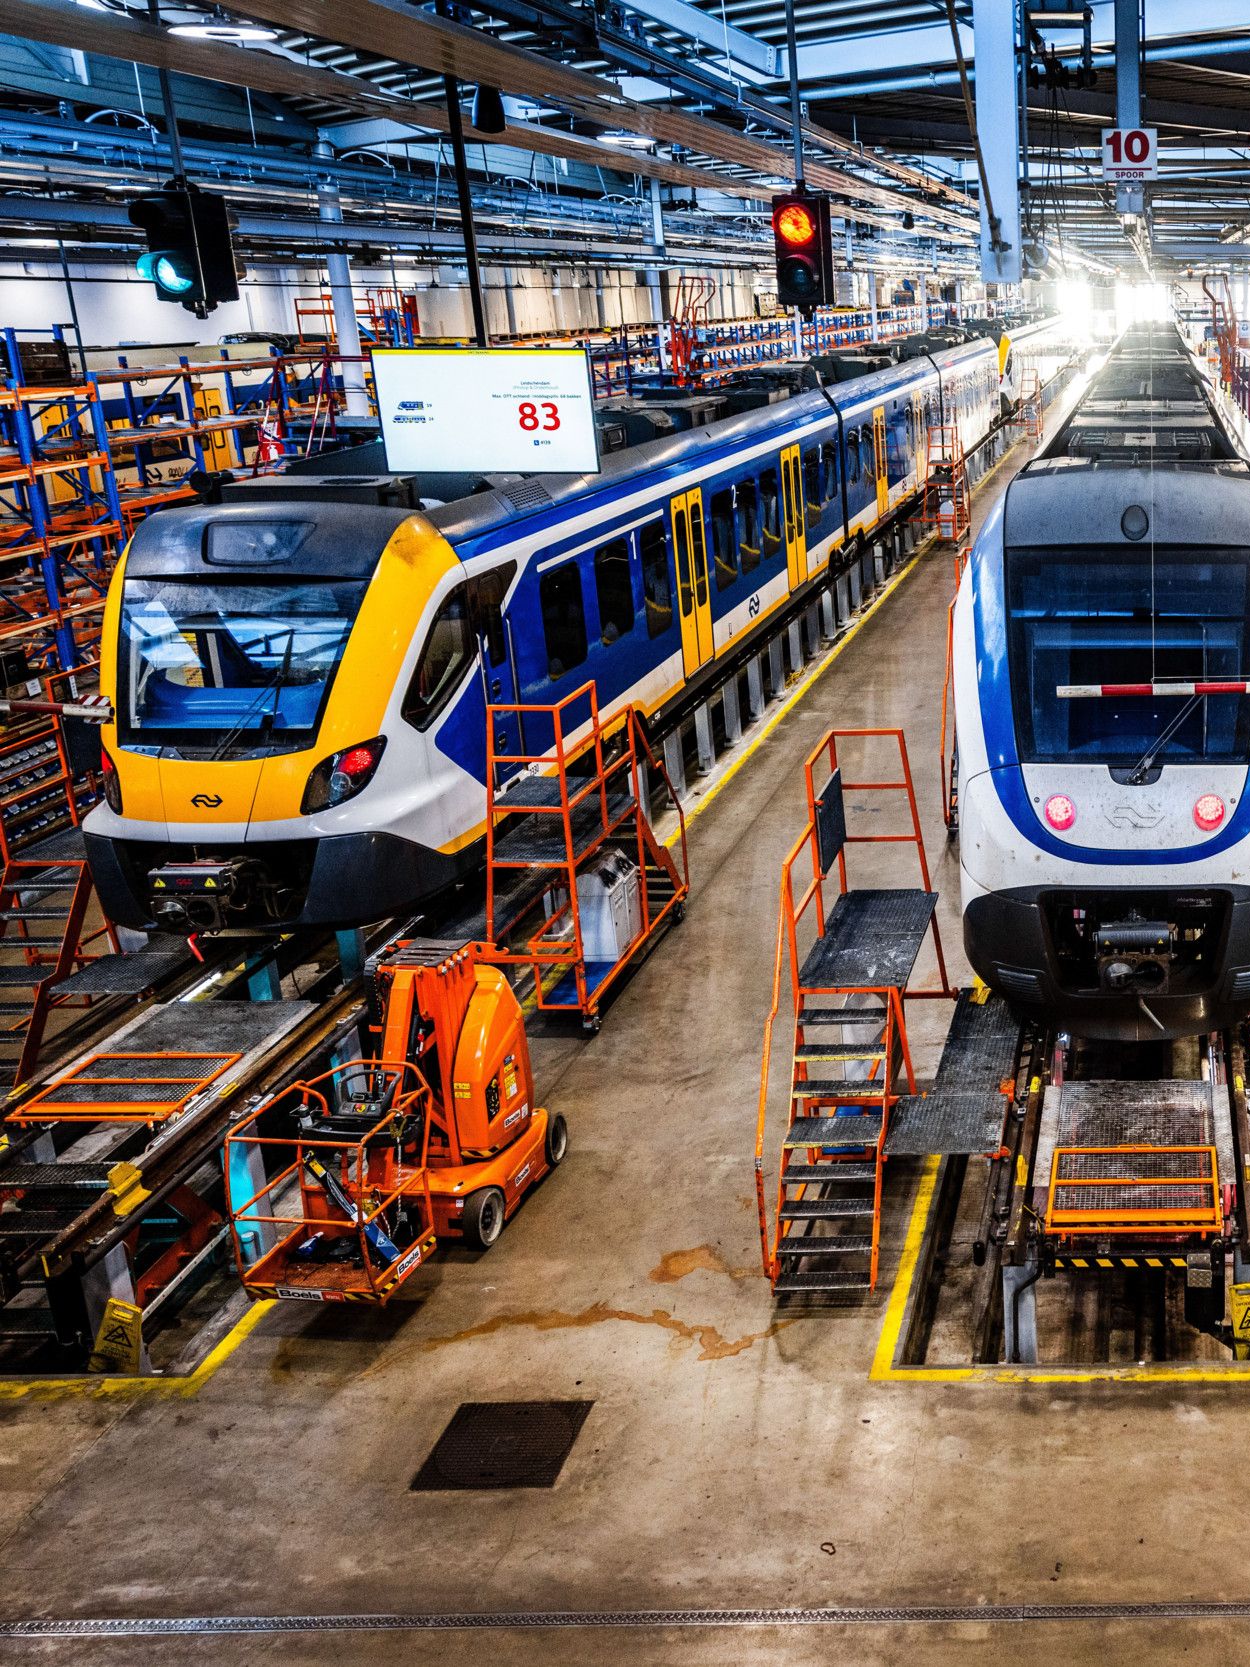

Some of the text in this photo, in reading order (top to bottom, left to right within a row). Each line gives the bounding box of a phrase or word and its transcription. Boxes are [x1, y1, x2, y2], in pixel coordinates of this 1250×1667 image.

[1106, 131, 1149, 163] 10
[519, 402, 560, 431] 83
[630, 531, 637, 560] 1
[398, 1250, 420, 1274] Boels
[279, 1289, 321, 1300] Boels
